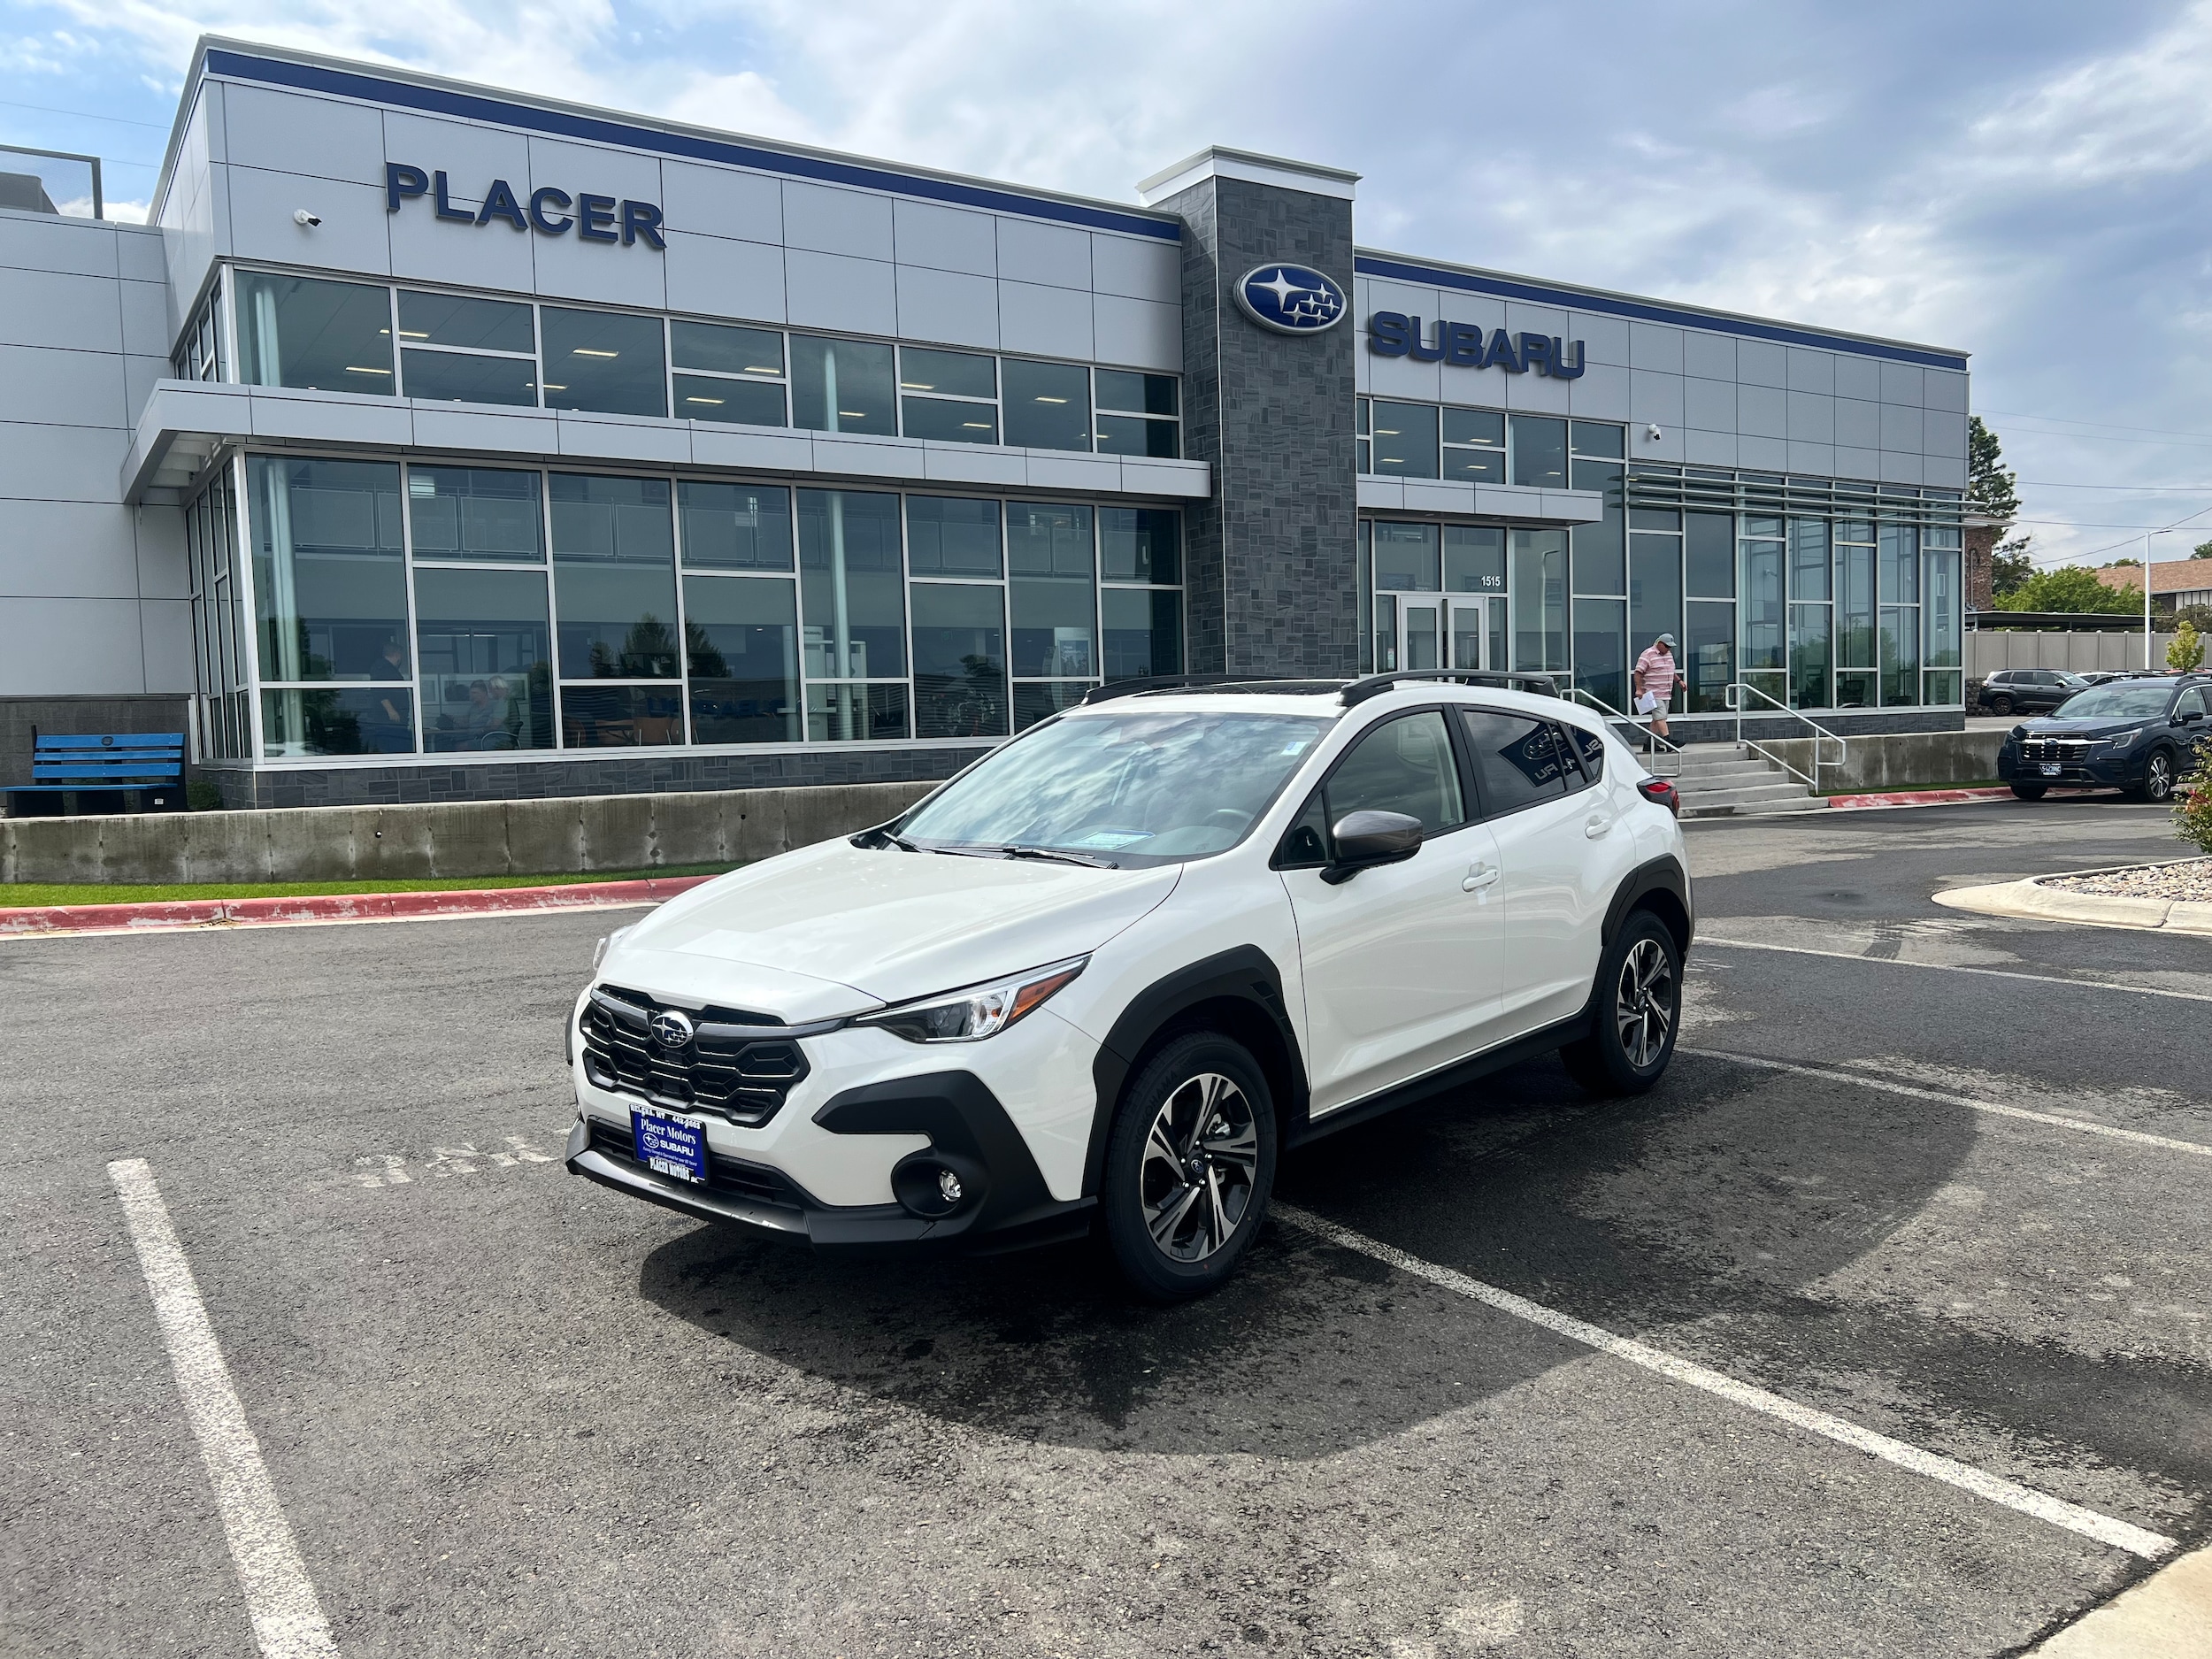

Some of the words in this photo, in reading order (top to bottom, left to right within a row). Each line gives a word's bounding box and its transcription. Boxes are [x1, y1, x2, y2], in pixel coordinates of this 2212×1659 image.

[384, 161, 667, 250] PLACER
[1371, 311, 1585, 379] SUBARU
[1481, 575, 1501, 587] 1515
[641, 1118, 665, 1136] Placer
[666, 1125, 696, 1145] Motors
[660, 1140, 694, 1156] SUBARU
[649, 1157, 669, 1174] PLACER
[669, 1164, 690, 1181] MOTORS
